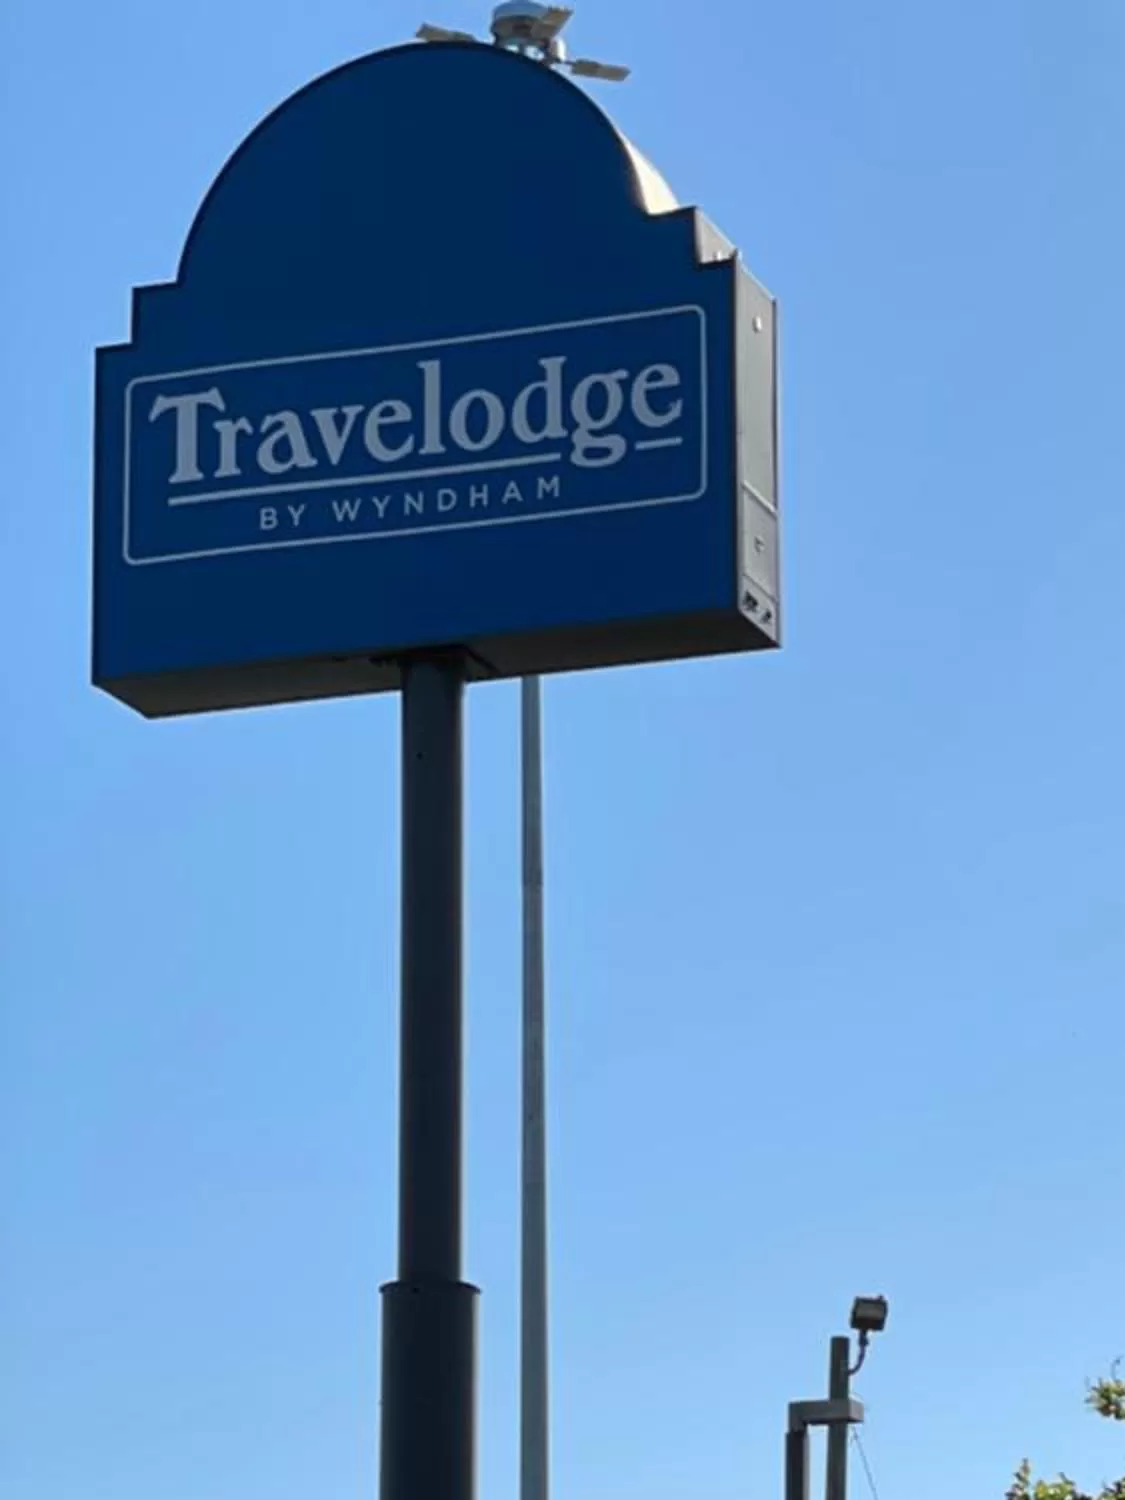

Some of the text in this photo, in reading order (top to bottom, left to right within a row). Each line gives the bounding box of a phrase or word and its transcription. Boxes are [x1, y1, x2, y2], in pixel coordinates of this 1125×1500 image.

[149, 356, 683, 484] Travelodge
[259, 476, 560, 530] BY WYNDHAM
